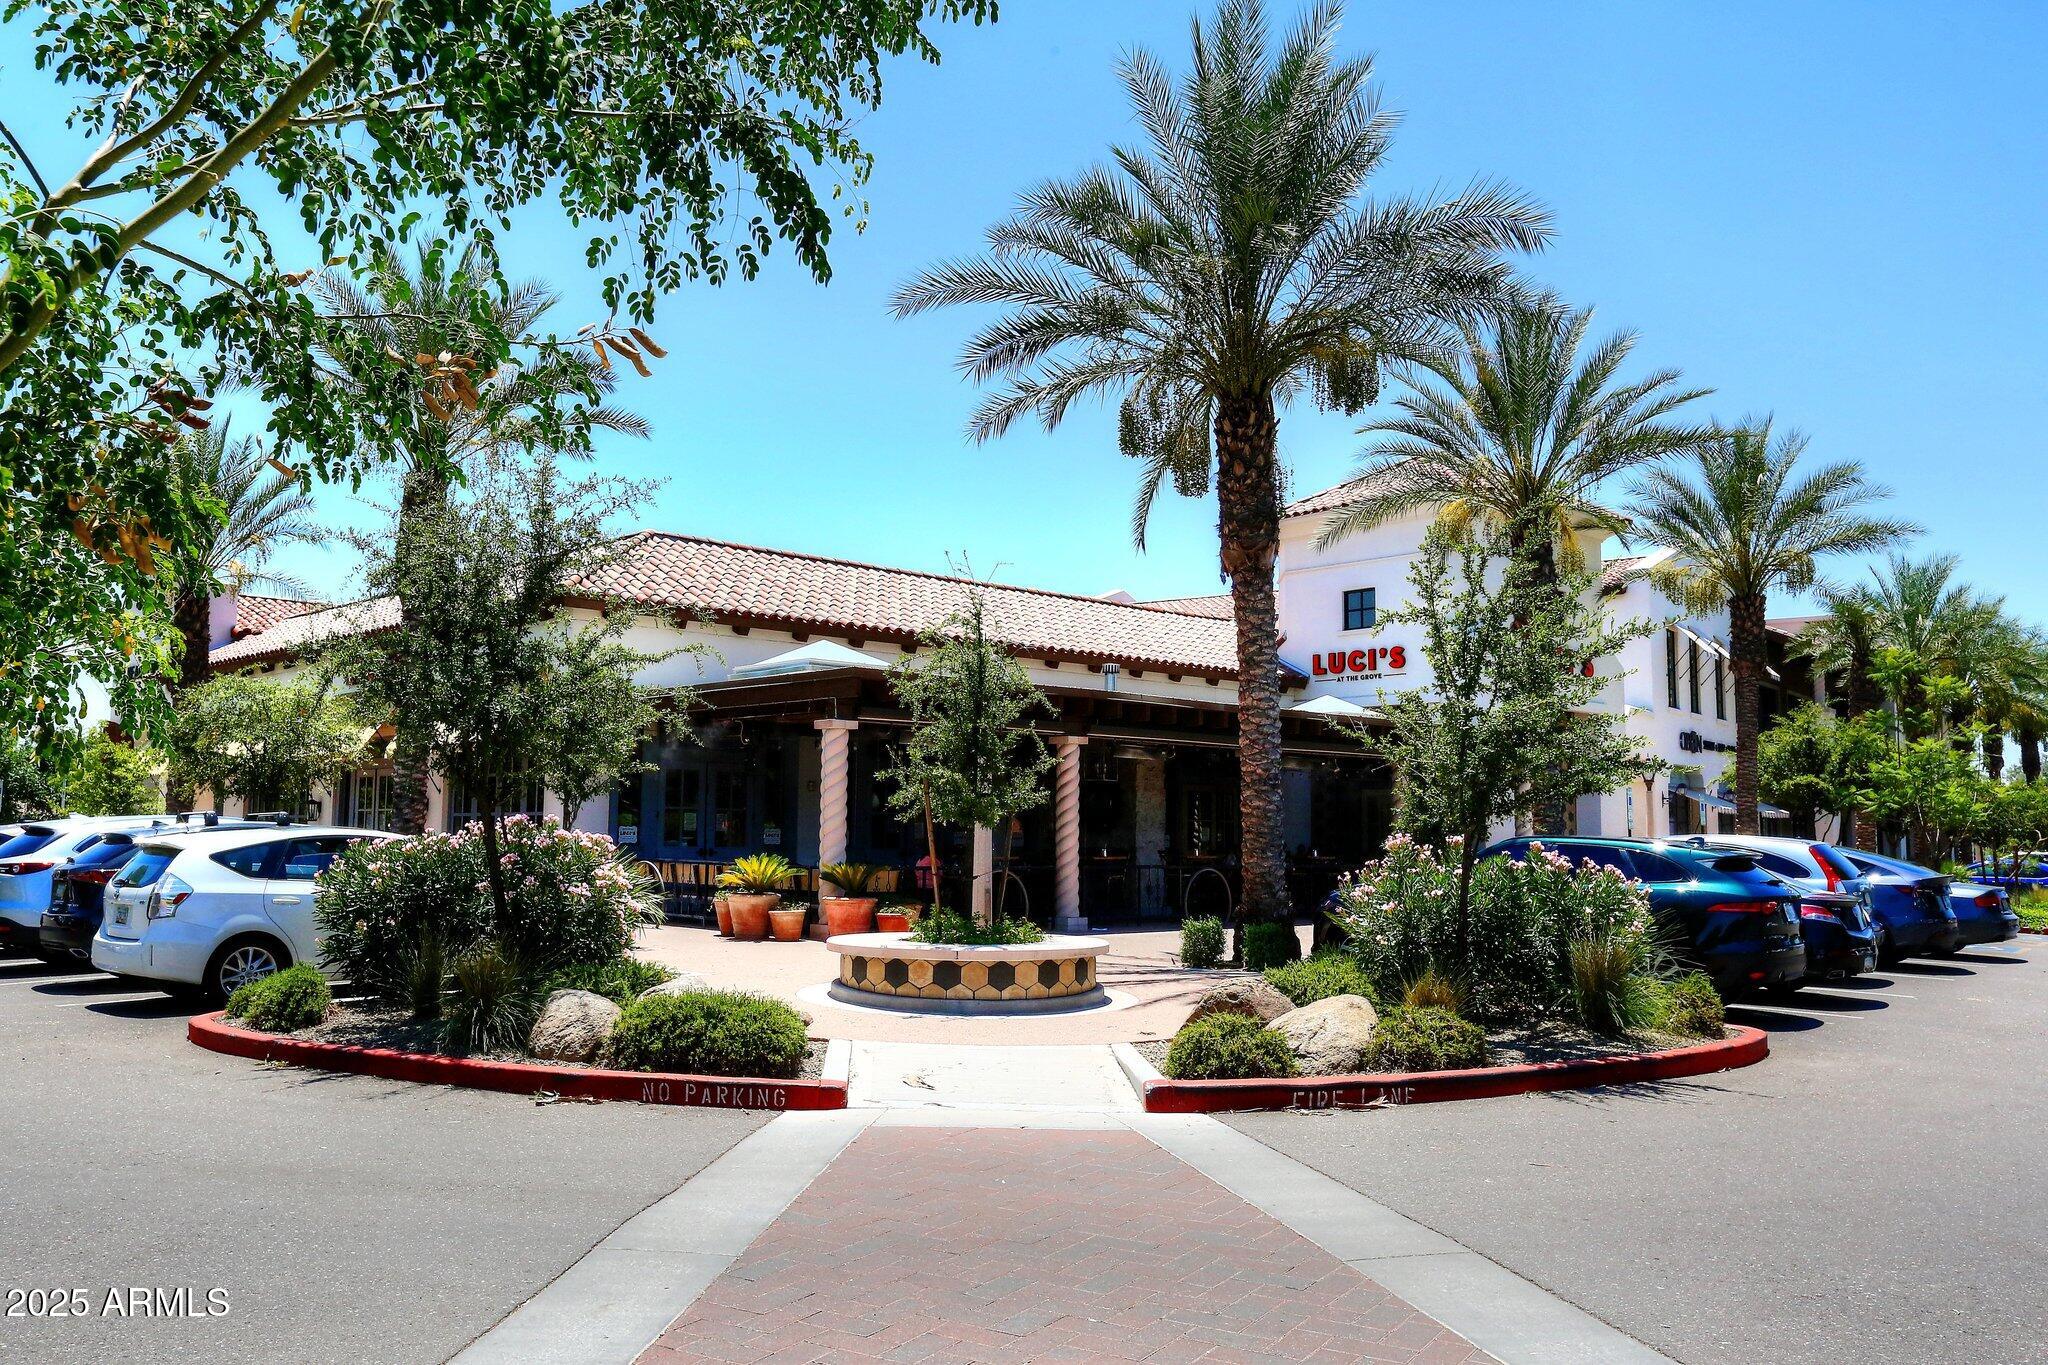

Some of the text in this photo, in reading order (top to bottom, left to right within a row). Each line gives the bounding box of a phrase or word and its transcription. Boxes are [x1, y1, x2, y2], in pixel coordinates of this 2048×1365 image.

[1312, 645, 1407, 676] LUCI'S
[642, 1082, 786, 1107] NO PARKING
